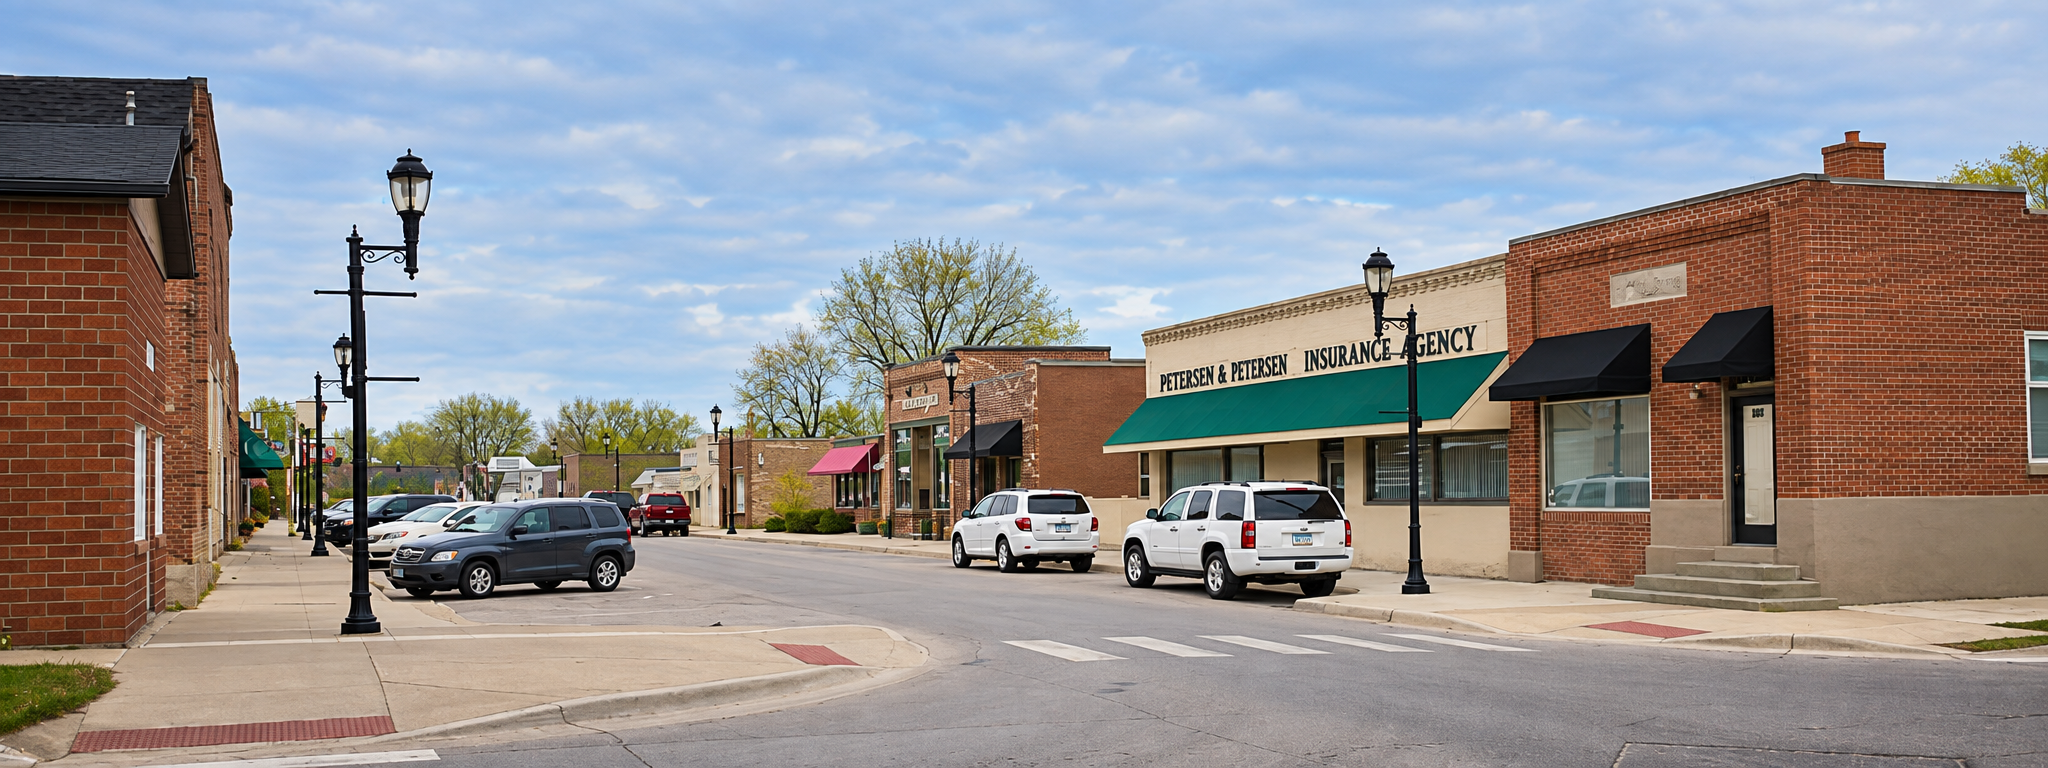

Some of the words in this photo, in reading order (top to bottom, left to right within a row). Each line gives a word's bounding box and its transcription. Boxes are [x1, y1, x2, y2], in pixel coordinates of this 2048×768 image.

[1160, 365, 1215, 392] PETERSEN
[1217, 364, 1227, 384] &
[1231, 353, 1288, 382] PETERSEN
[1304, 338, 1391, 372] INSURANCE
[1400, 325, 1477, 359] AGENCY
